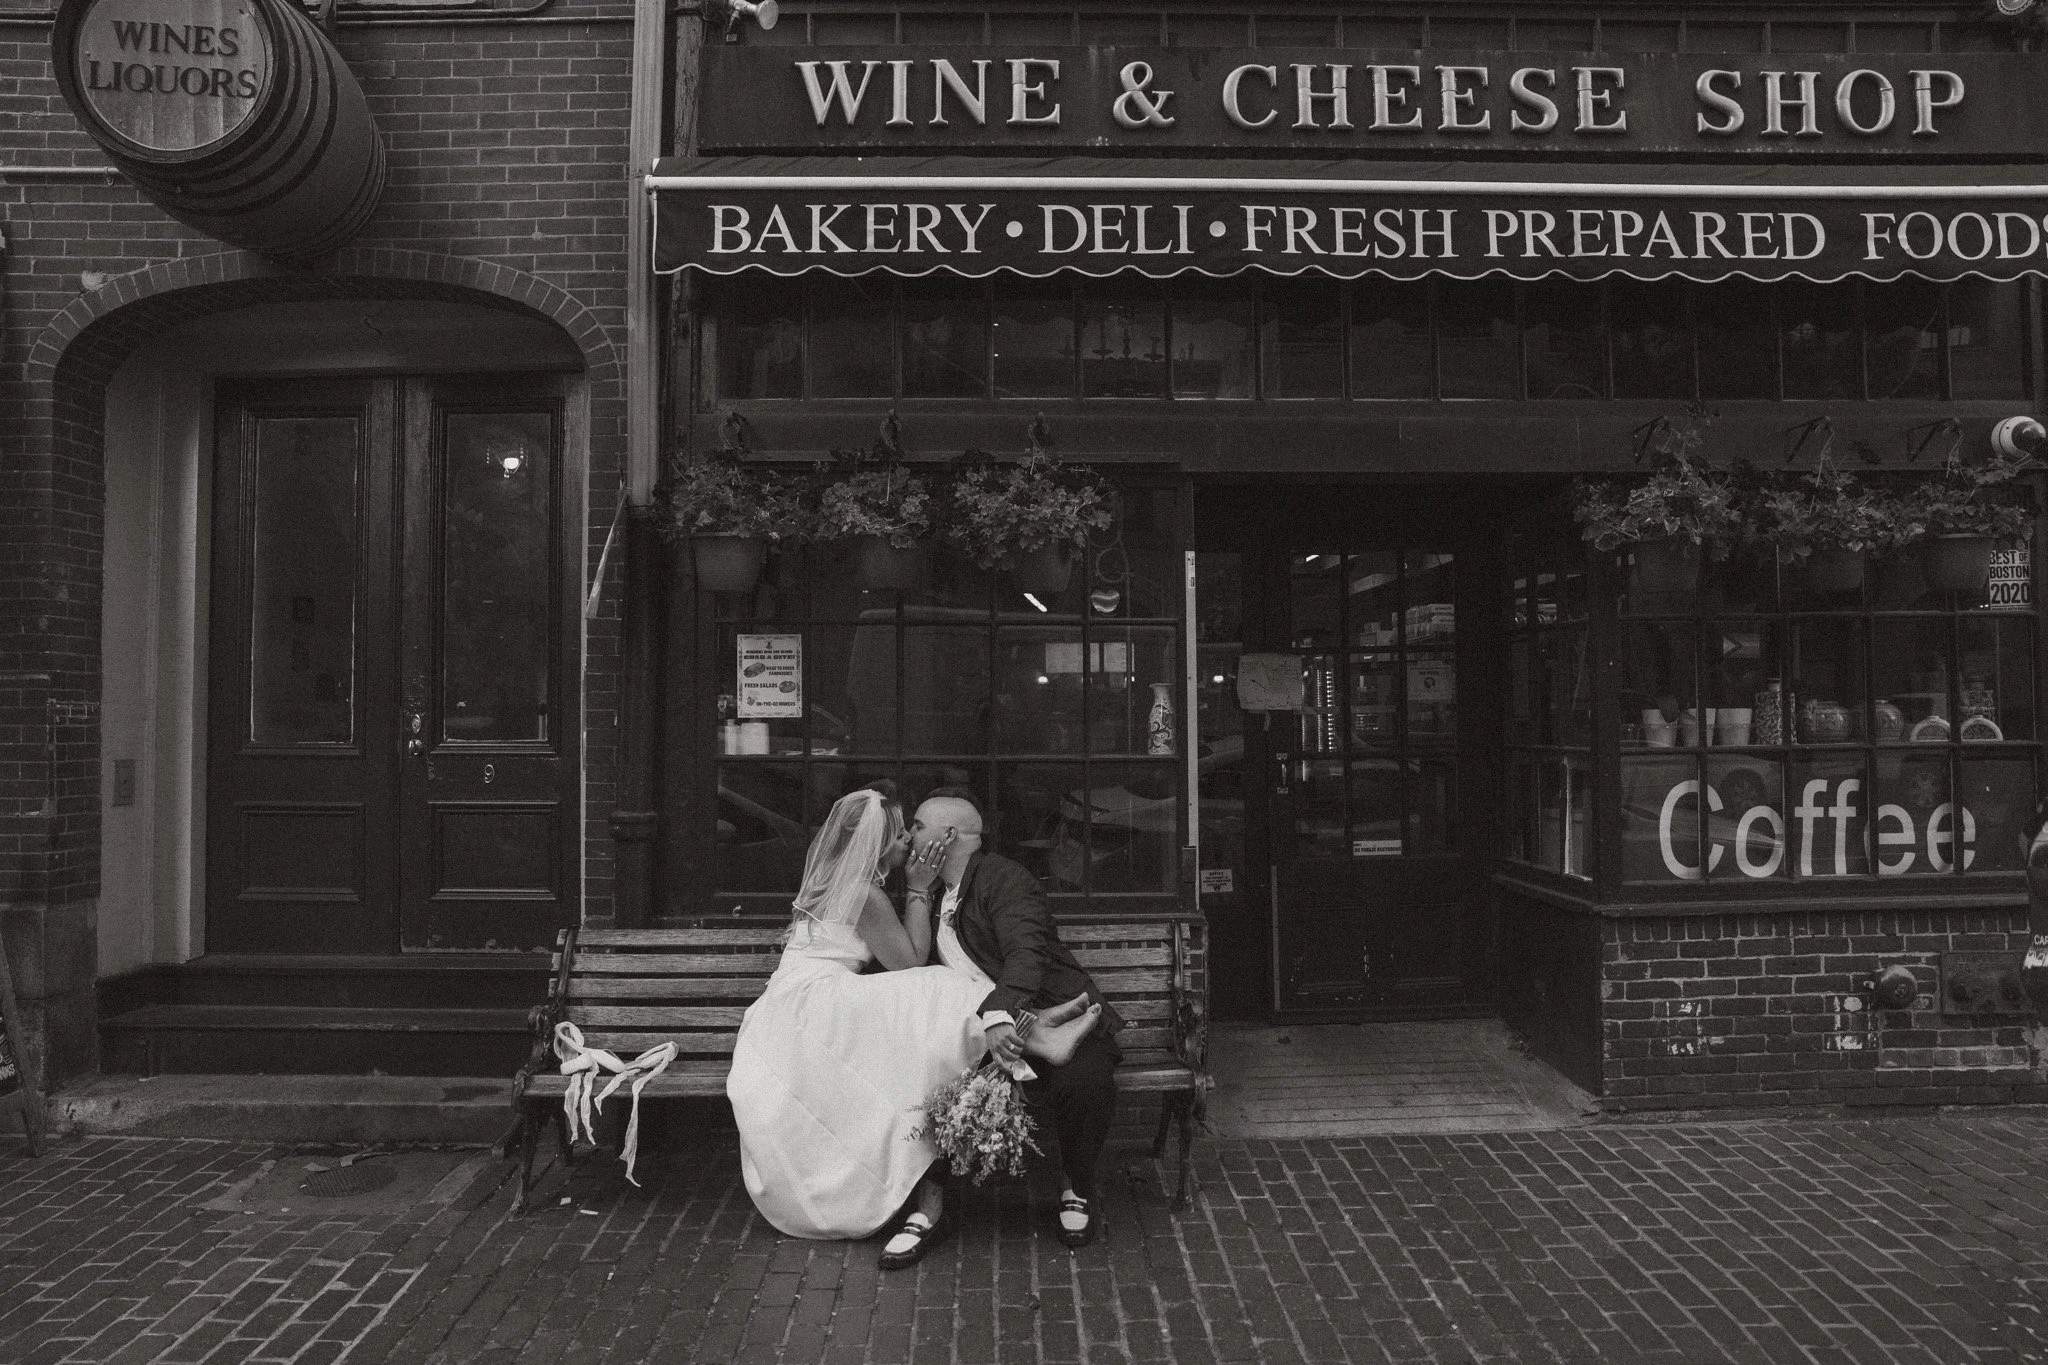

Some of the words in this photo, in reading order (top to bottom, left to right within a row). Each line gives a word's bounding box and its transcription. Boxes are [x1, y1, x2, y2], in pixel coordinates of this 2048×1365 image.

[111, 20, 240, 57] WINES
[87, 60, 258, 100] LIQUORS
[794, 58, 1062, 126] WINE
[1112, 61, 1175, 130] &
[1221, 63, 1628, 133] CHEESE
[1695, 68, 1966, 137] SHOP
[706, 203, 997, 255] BAKERY
[1037, 204, 1195, 255] DELI
[1239, 205, 1459, 258] FRESH
[1482, 208, 1827, 260] PREPARED
[1859, 210, 2048, 261] FOOD
[1989, 565, 2030, 579] BOSTON
[1990, 550, 2017, 565] BEST
[2018, 552, 2028, 561] OF
[1990, 582, 2030, 605] 2020
[484, 764, 495, 784] 9
[1658, 778, 1977, 881] Coffee
